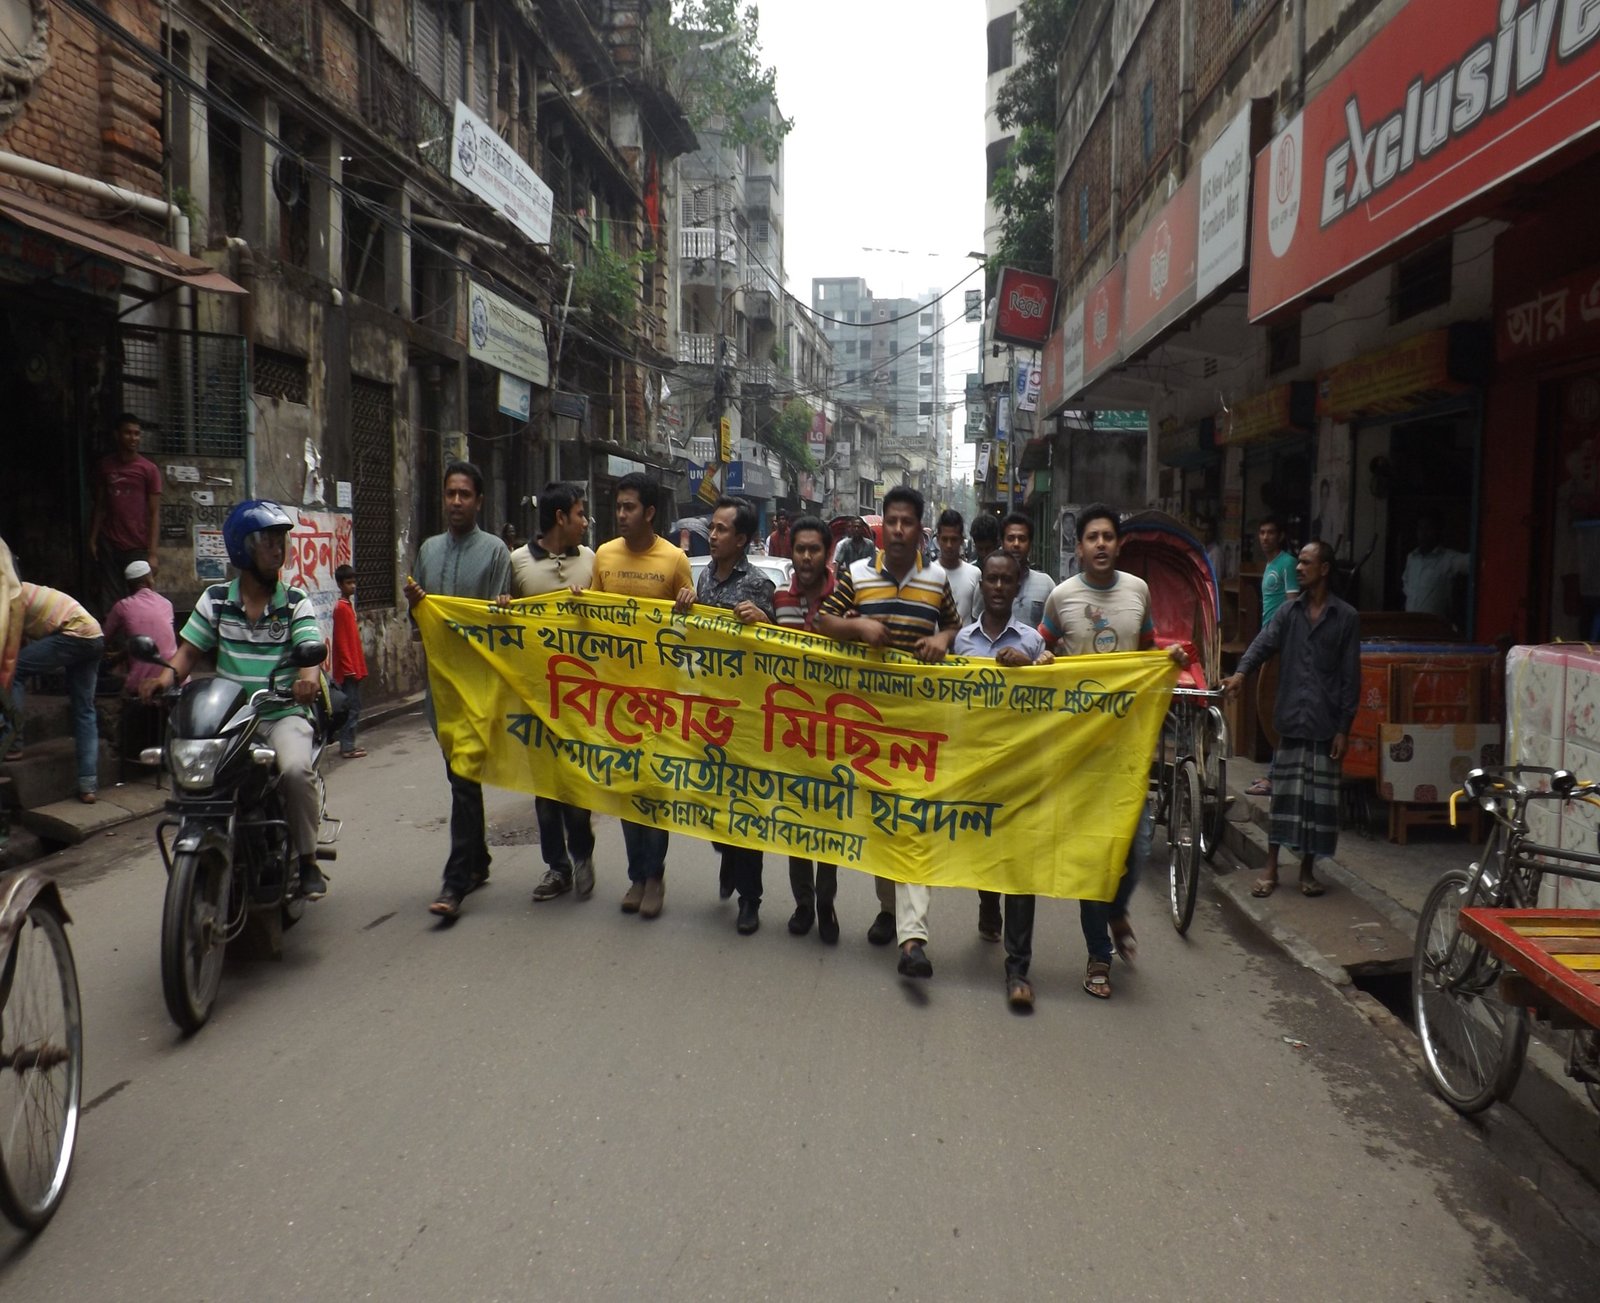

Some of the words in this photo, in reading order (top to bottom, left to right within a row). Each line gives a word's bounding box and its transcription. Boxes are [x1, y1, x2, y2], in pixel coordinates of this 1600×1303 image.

[1319, 0, 1600, 229] Exclusive
[1008, 290, 1048, 318] Regal
[1506, 287, 1570, 347] আর
[810, 431, 824, 441] LG
[645, 607, 663, 624] ও
[537, 626, 647, 669] খালেদা
[655, 627, 746, 679] জিয়ার
[753, 651, 799, 686] নামে
[803, 654, 852, 690] মিথ্যা
[857, 667, 916, 698] মামলা
[917, 677, 935, 699] ও
[937, 667, 1007, 710] চার্জশীট
[1008, 684, 1058, 713] দেয়ার
[1058, 679, 1137, 719] প্রতিবাদে
[545, 654, 741, 746] বিক্ষোভ
[760, 681, 949, 787] মিছিল
[650, 743, 859, 821] জাতীয়তাবাদী
[867, 789, 1004, 841] ছাত্রদল
[632, 793, 722, 830] জগন্নাথ
[728, 798, 867, 862] বিশ্ববিদ্যালয়
